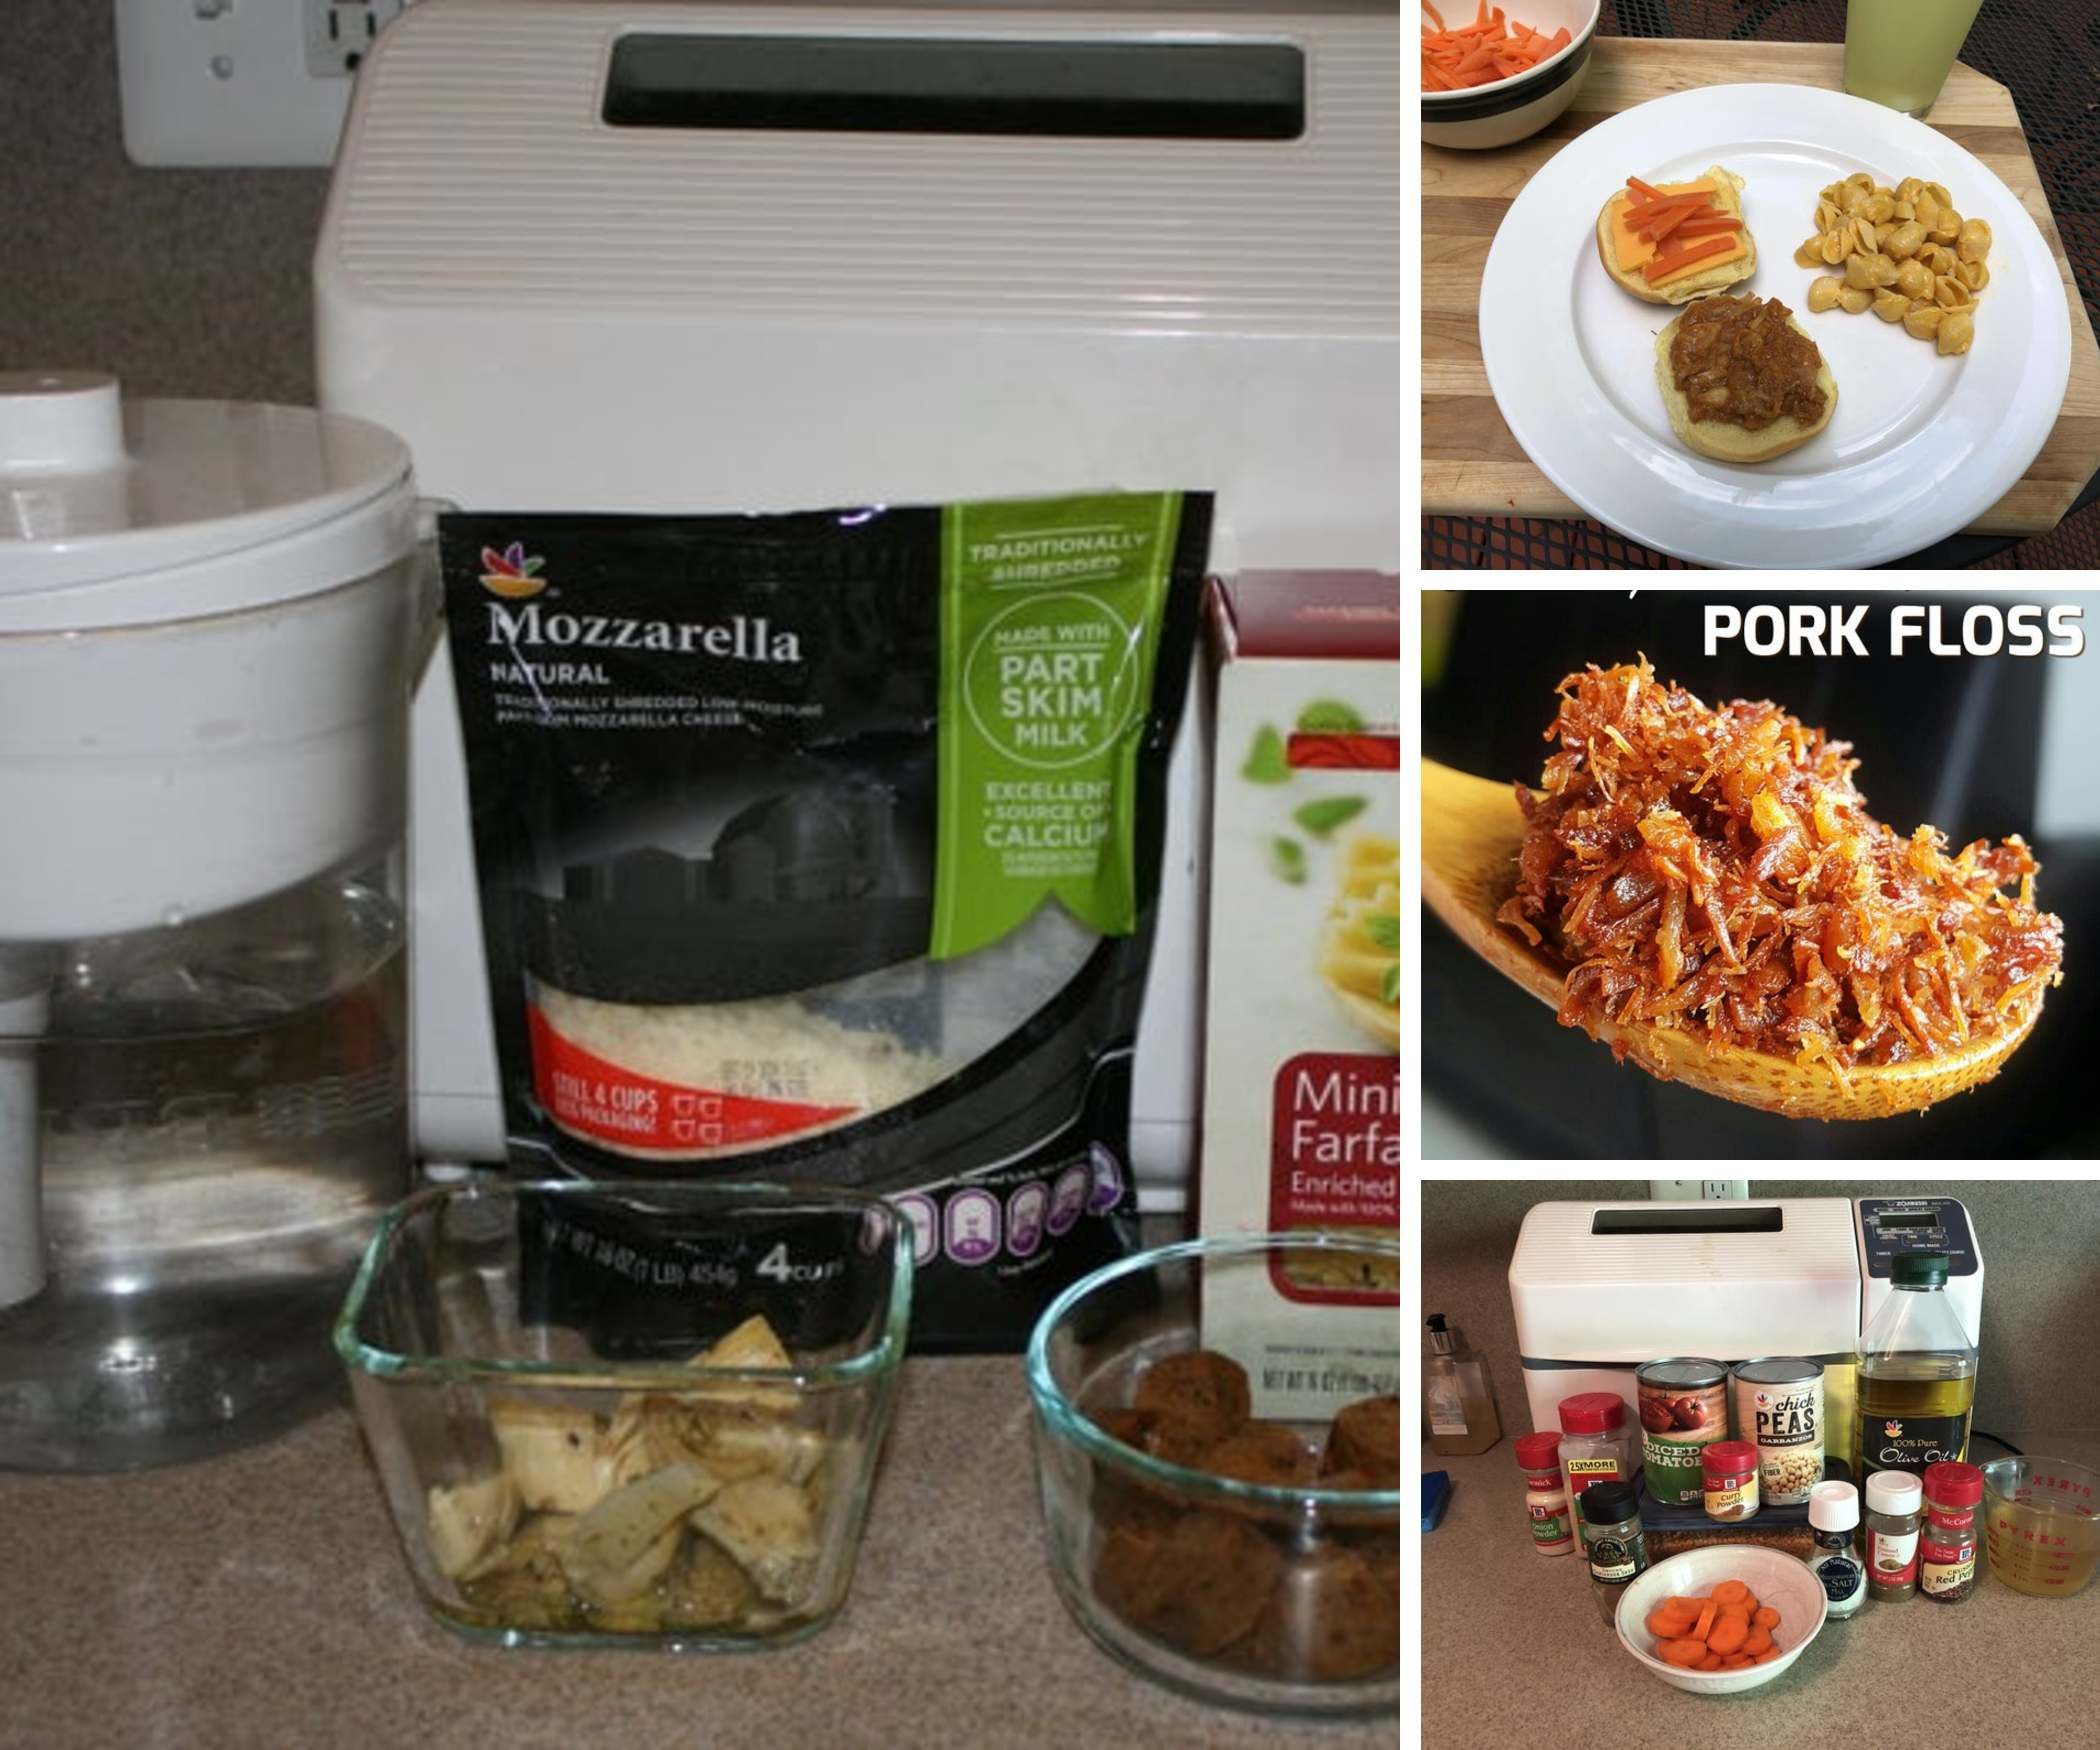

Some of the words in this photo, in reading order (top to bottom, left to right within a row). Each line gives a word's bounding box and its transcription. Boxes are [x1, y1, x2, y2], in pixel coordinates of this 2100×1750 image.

[968, 533, 1147, 562] TRADITIONALLY
[486, 602, 802, 662] Mozzarella
[994, 626, 1050, 647] MADE
[1057, 622, 1111, 642] WITH
[490, 662, 610, 685] NATURAL
[1000, 653, 1104, 684] PART
[1001, 686, 1103, 719] SKIM
[574, 712, 677, 727] MOZZARELLA
[681, 712, 745, 726] CHEESE
[1014, 722, 1089, 748] MILK
[994, 804, 1074, 821] SOURCE
[611, 1085, 659, 1115] CUPS
[1294, 1069, 1400, 1115] Mini
[1291, 1170, 1395, 1197] Enriched
[1775, 1392, 1816, 1412] chick
[1755, 1407, 1814, 1434] PEAS
[1646, 1442, 1700, 1457] DICED
[1893, 1439, 1916, 1447] 100%
[1917, 1439, 1938, 1447] Pure
[1583, 1460, 1615, 1469] MORE
[1879, 1447, 1921, 1463] Olive
[1924, 1449, 1950, 1463] Oil
[1763, 1467, 1781, 1477] FIBER
[1720, 1491, 1742, 1501] Curry
[1831, 1578, 1854, 1588] SALT
[1935, 1574, 1955, 1584] Red
